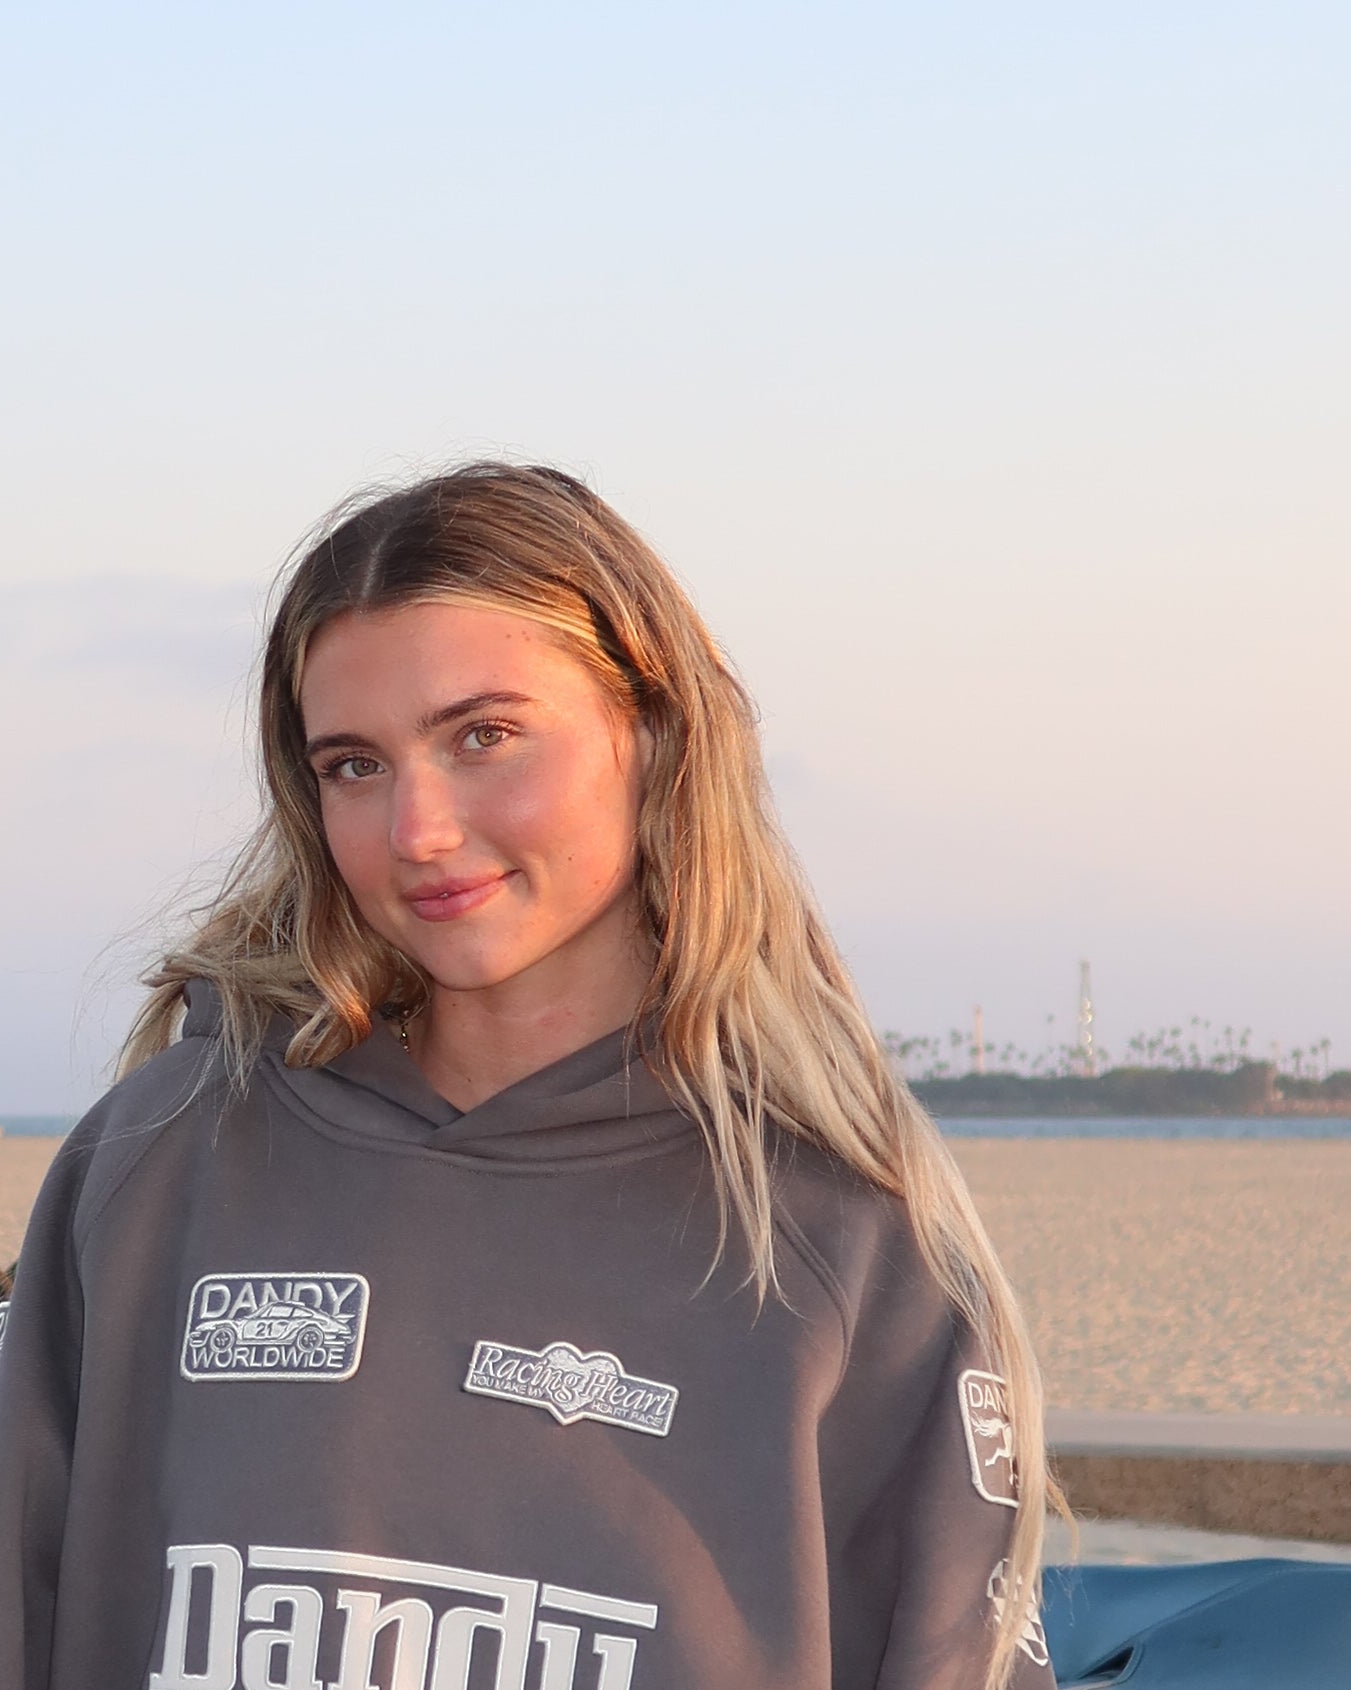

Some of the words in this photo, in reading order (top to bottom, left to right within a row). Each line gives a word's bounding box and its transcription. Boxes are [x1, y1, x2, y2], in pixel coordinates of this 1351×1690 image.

[200, 1281, 358, 1319] DANDY
[191, 1347, 346, 1369] WORLDWIDE
[472, 1375, 495, 1388] YOU
[473, 1346, 580, 1403] Racing
[579, 1370, 674, 1416] Heart
